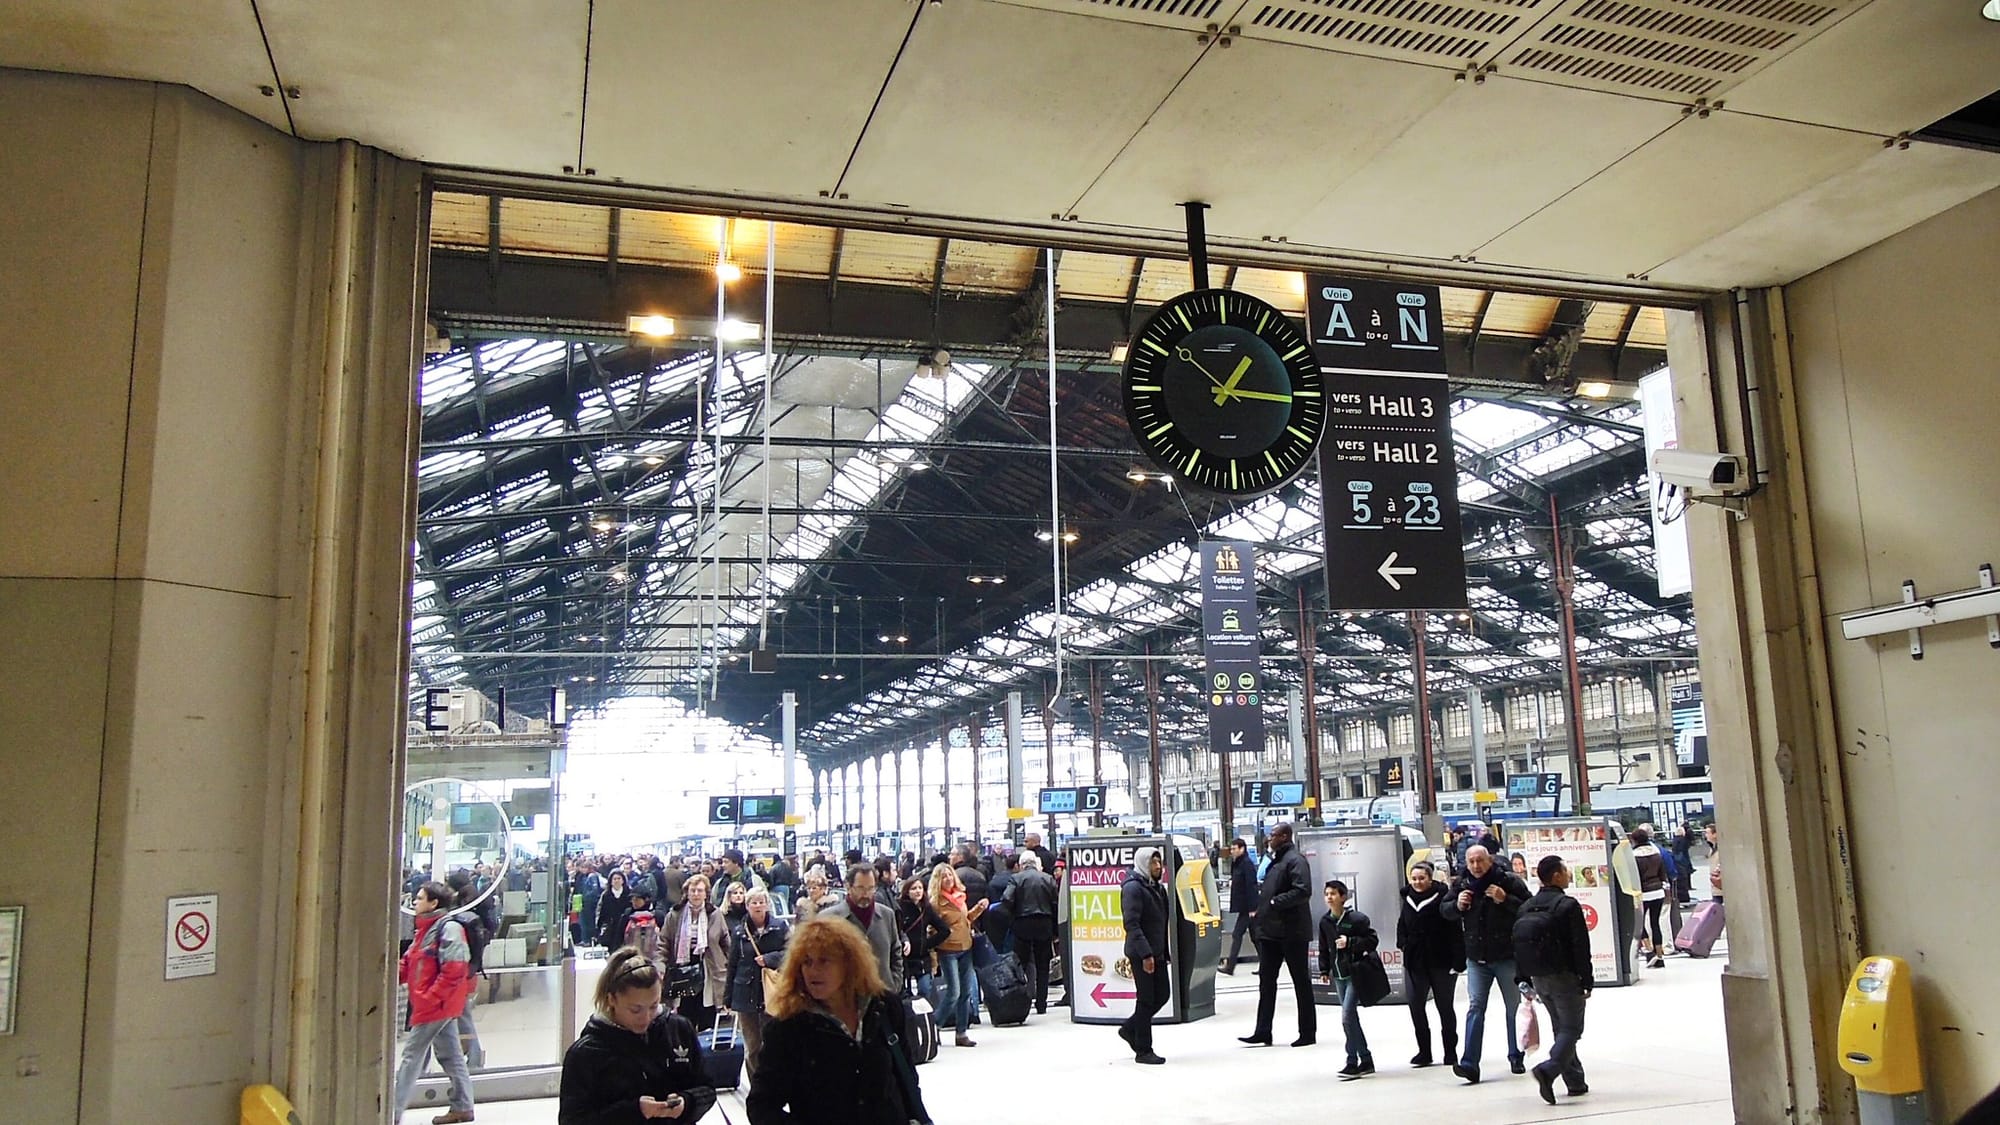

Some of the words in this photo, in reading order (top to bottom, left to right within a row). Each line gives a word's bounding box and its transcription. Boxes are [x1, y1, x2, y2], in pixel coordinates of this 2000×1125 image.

[1326, 289, 1348, 299] Voie
[1400, 295, 1421, 305] Voie
[1326, 303, 1355, 338] A
[1371, 309, 1381, 326] à
[1399, 308, 1428, 342] N
[1366, 331, 1375, 340] to
[1333, 393, 1361, 404] vers
[1369, 395, 1415, 417] Hall
[1420, 397, 1434, 418] 3
[1336, 440, 1365, 450] vers
[1373, 442, 1420, 463] Hall
[1425, 443, 1439, 463] 2
[1351, 482, 1369, 491] Voie
[1411, 484, 1429, 492] Voie
[1353, 494, 1371, 523] 5
[1387, 498, 1396, 512] à
[1404, 495, 1441, 524] 23
[1383, 516, 1391, 524] to
[1212, 575, 1245, 584] Toilettes
[1206, 633, 1232, 641] Location
[1232, 633, 1257, 641] voitures
[1545, 780, 1556, 793] G
[1086, 793, 1099, 808] D
[1251, 788, 1261, 803] E
[717, 804, 730, 820] C
[1074, 926, 1088, 938] DE
[1091, 926, 1122, 939] 6H30
